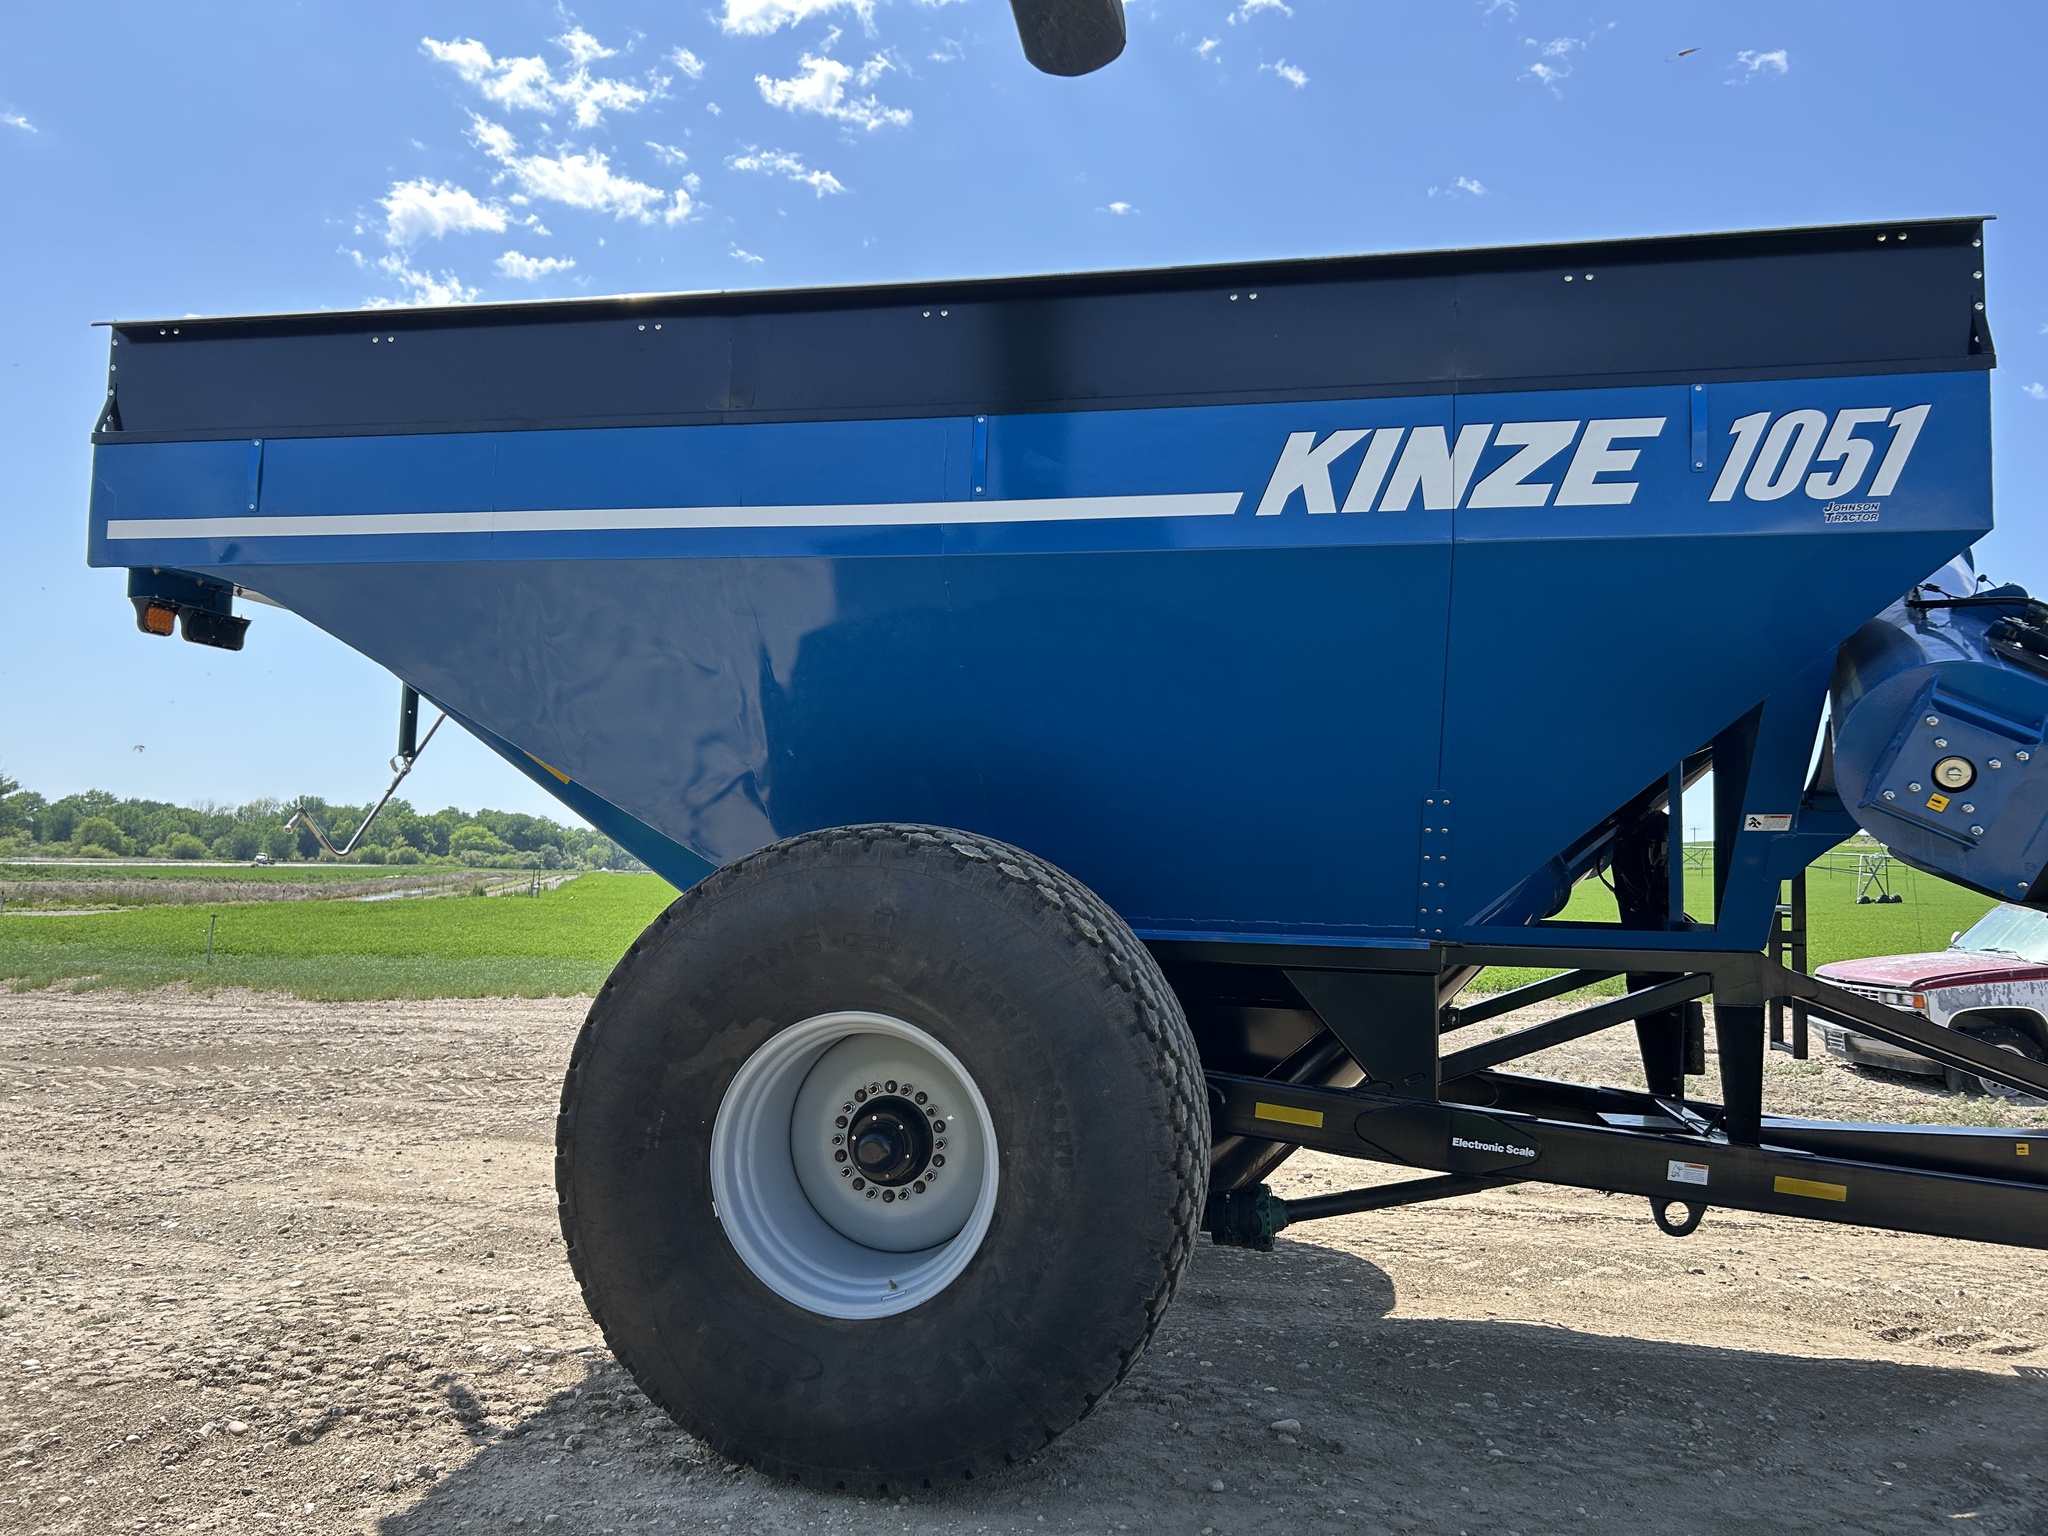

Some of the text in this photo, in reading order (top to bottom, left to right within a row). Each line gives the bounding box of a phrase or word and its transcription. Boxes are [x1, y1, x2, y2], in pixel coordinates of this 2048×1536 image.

[1256, 404, 1931, 516] KINZE 1051
[1823, 502, 1880, 513] JOHNSON
[1824, 512, 1879, 523] TRACTOR
[1452, 1137, 1536, 1157] Electronic Scale
